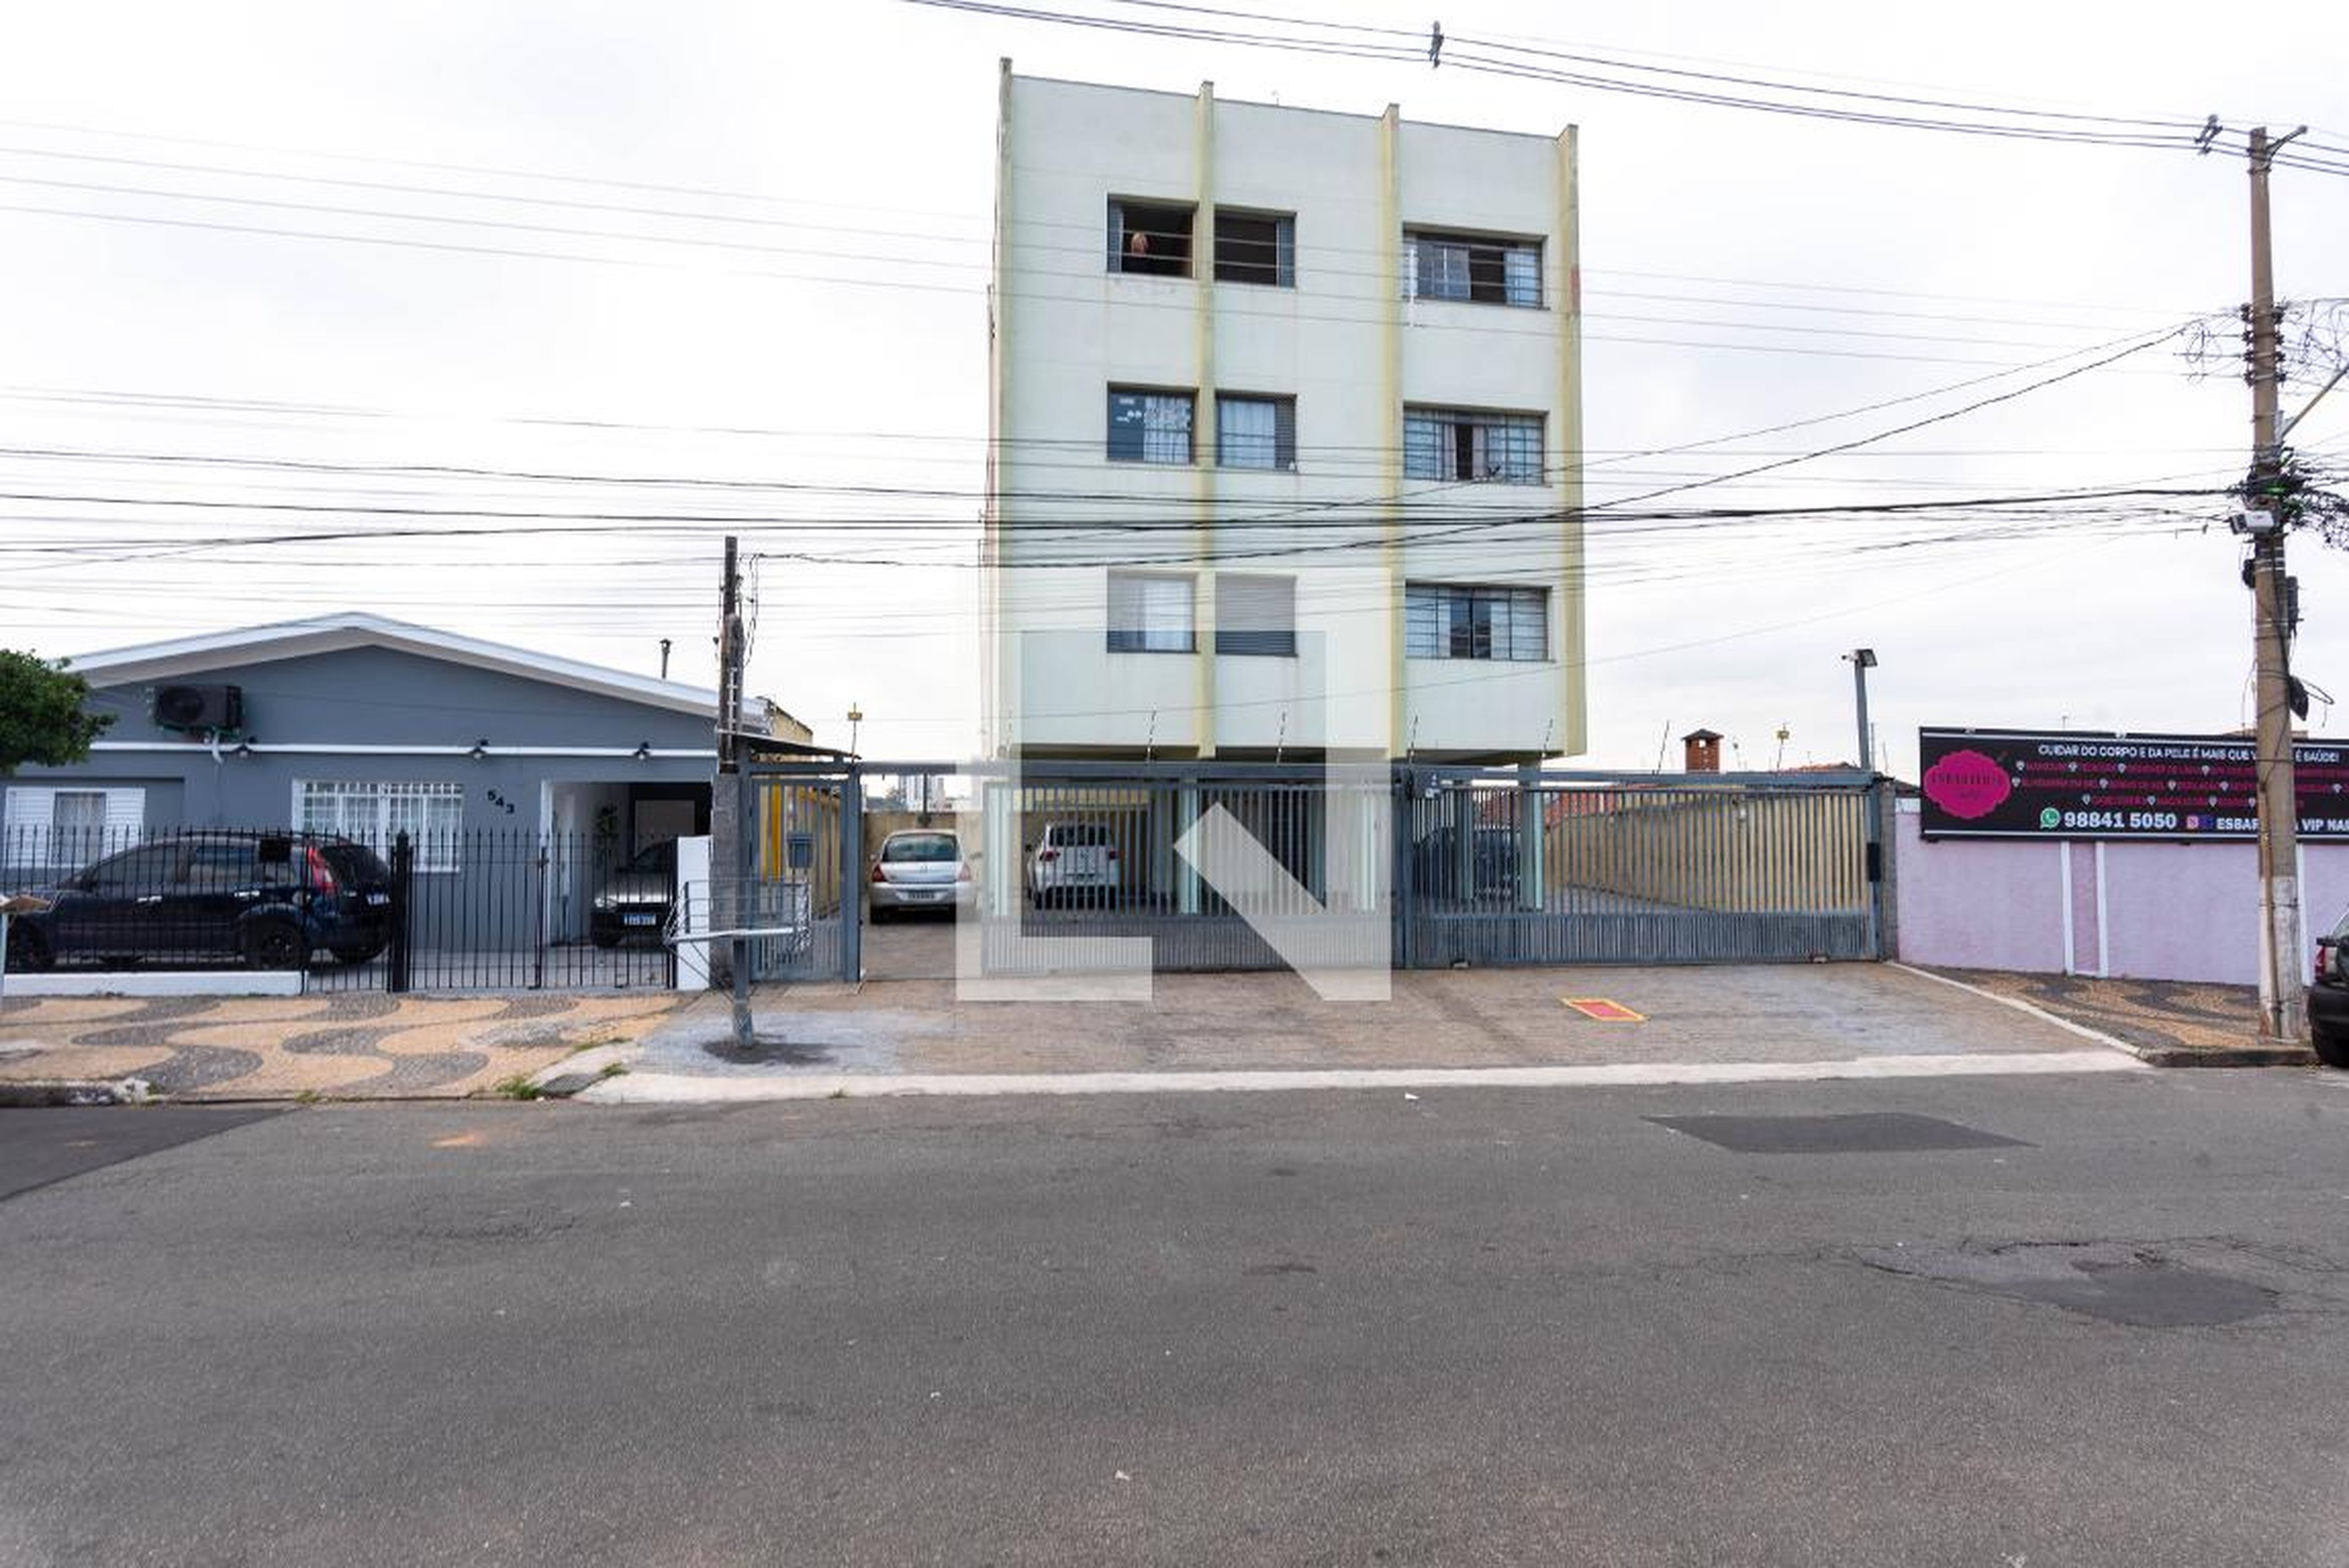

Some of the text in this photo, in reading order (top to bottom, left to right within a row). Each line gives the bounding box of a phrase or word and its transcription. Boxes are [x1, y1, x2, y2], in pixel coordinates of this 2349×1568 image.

[2038, 745, 2079, 756] CUIDAR
[2081, 745, 2097, 756] DO
[2099, 746, 2137, 757] CORPO
[2140, 747, 2146, 758] E
[2148, 747, 2163, 758] DA
[2165, 748, 2190, 758] PELE
[2202, 749, 2225, 760] MAIS
[488, 789, 515, 815] 543
[2065, 812, 2176, 829] 98841 5050
[2301, 818, 2324, 831] VIP
